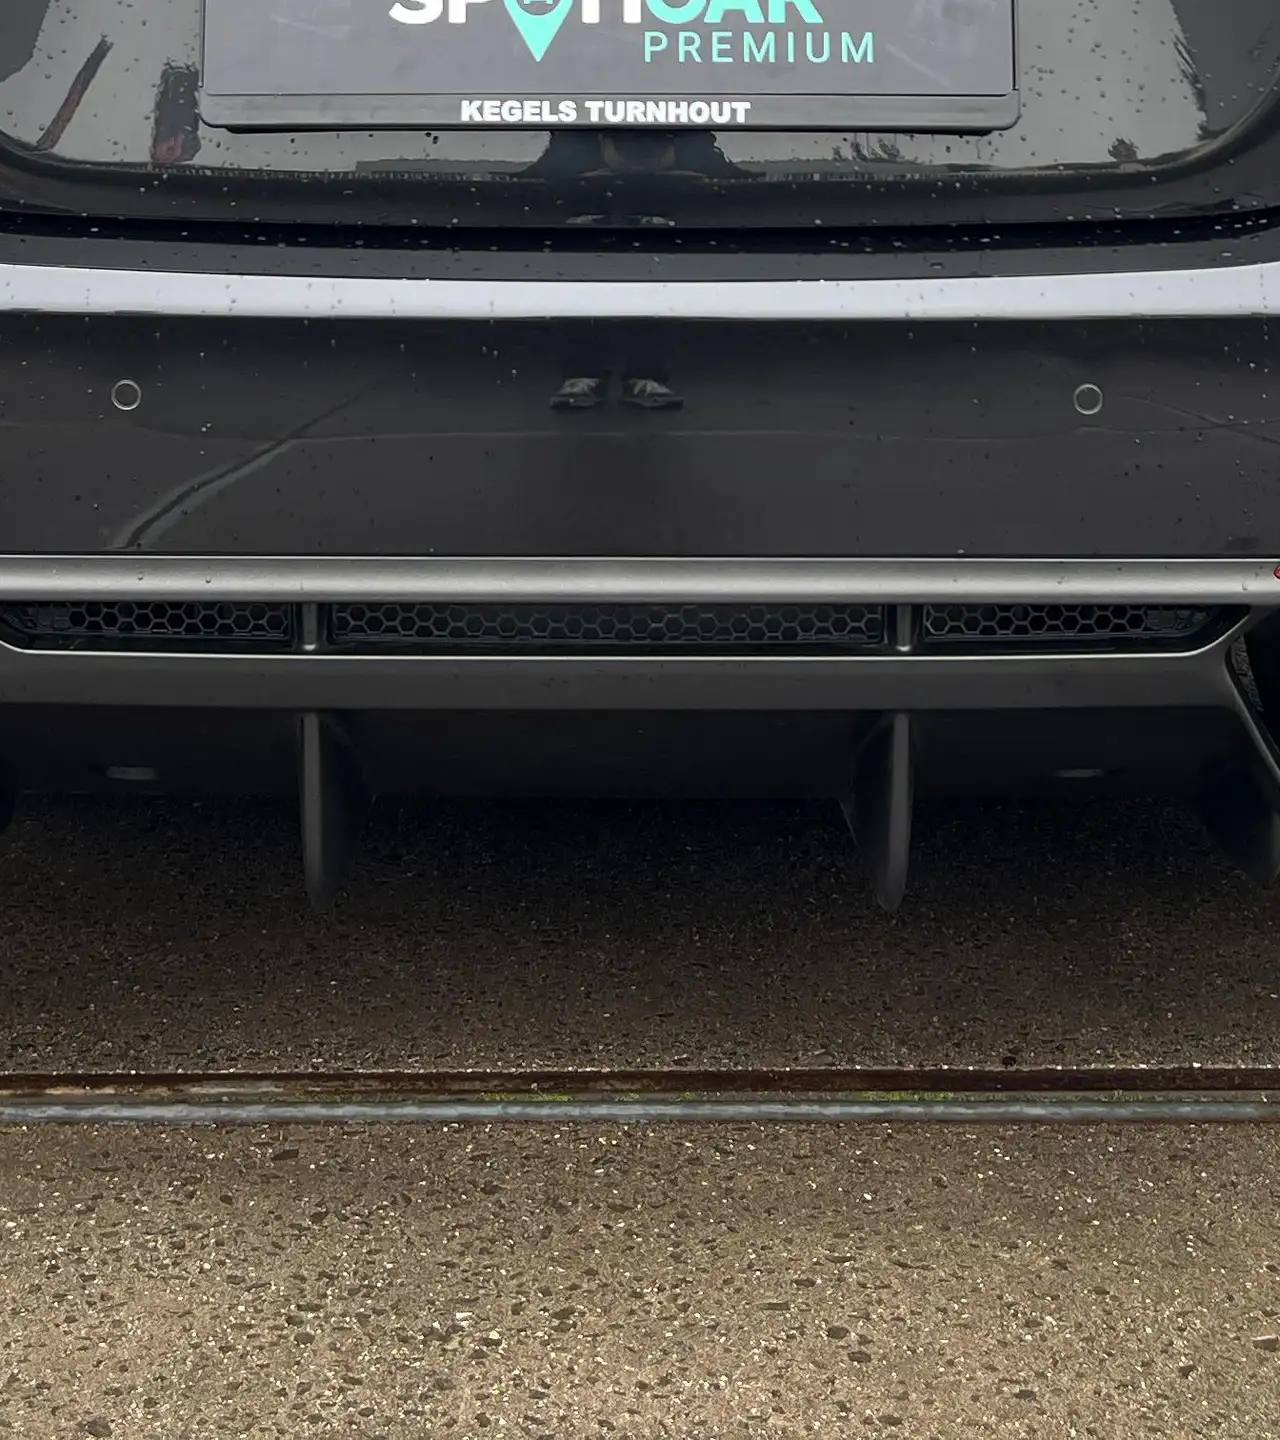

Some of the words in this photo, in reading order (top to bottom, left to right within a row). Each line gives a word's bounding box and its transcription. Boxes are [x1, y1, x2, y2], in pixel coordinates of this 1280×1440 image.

[643, 30, 876, 64] PREMIUM
[460, 99, 578, 123] KEGELS
[584, 100, 752, 125] TURNHOUT
